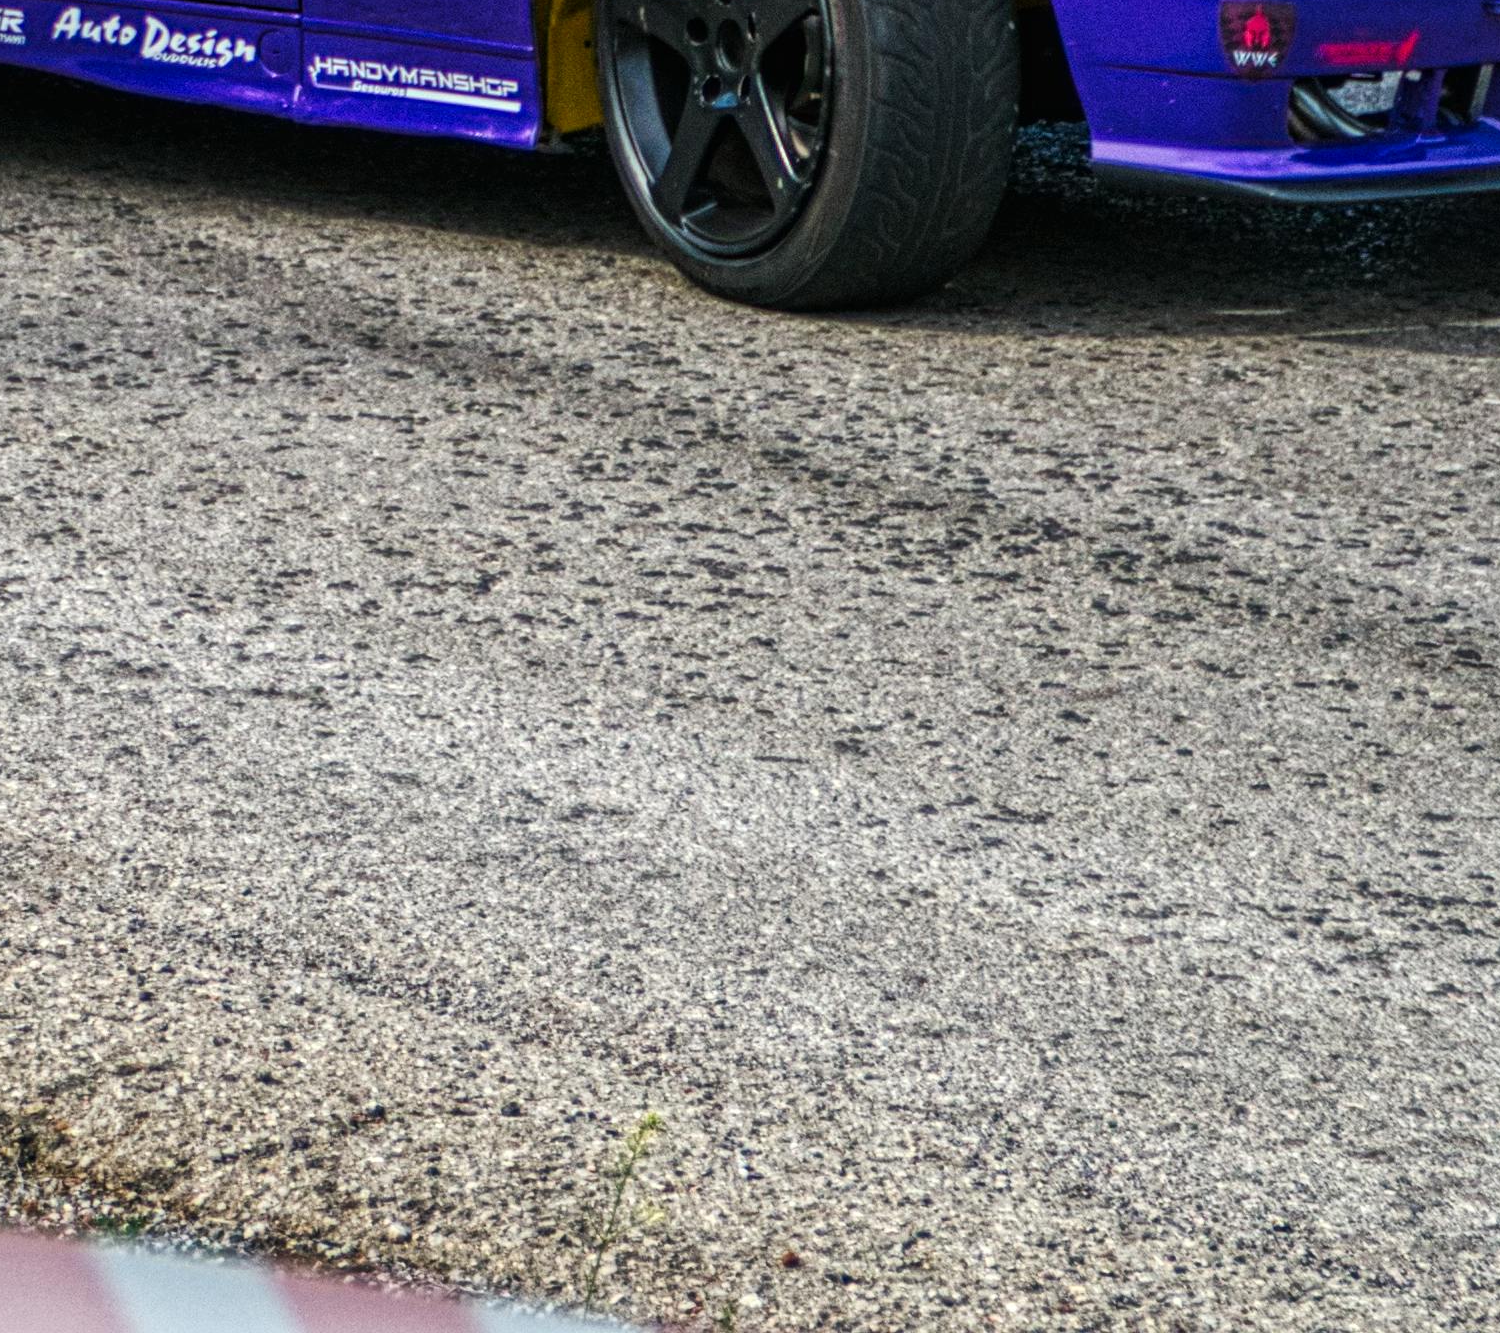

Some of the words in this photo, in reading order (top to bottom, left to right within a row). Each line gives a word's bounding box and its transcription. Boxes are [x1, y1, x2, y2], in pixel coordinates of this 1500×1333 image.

[51, 6, 137, 46] Auto
[141, 15, 257, 68] Design
[315, 55, 519, 97] HANDYMANSHOP
